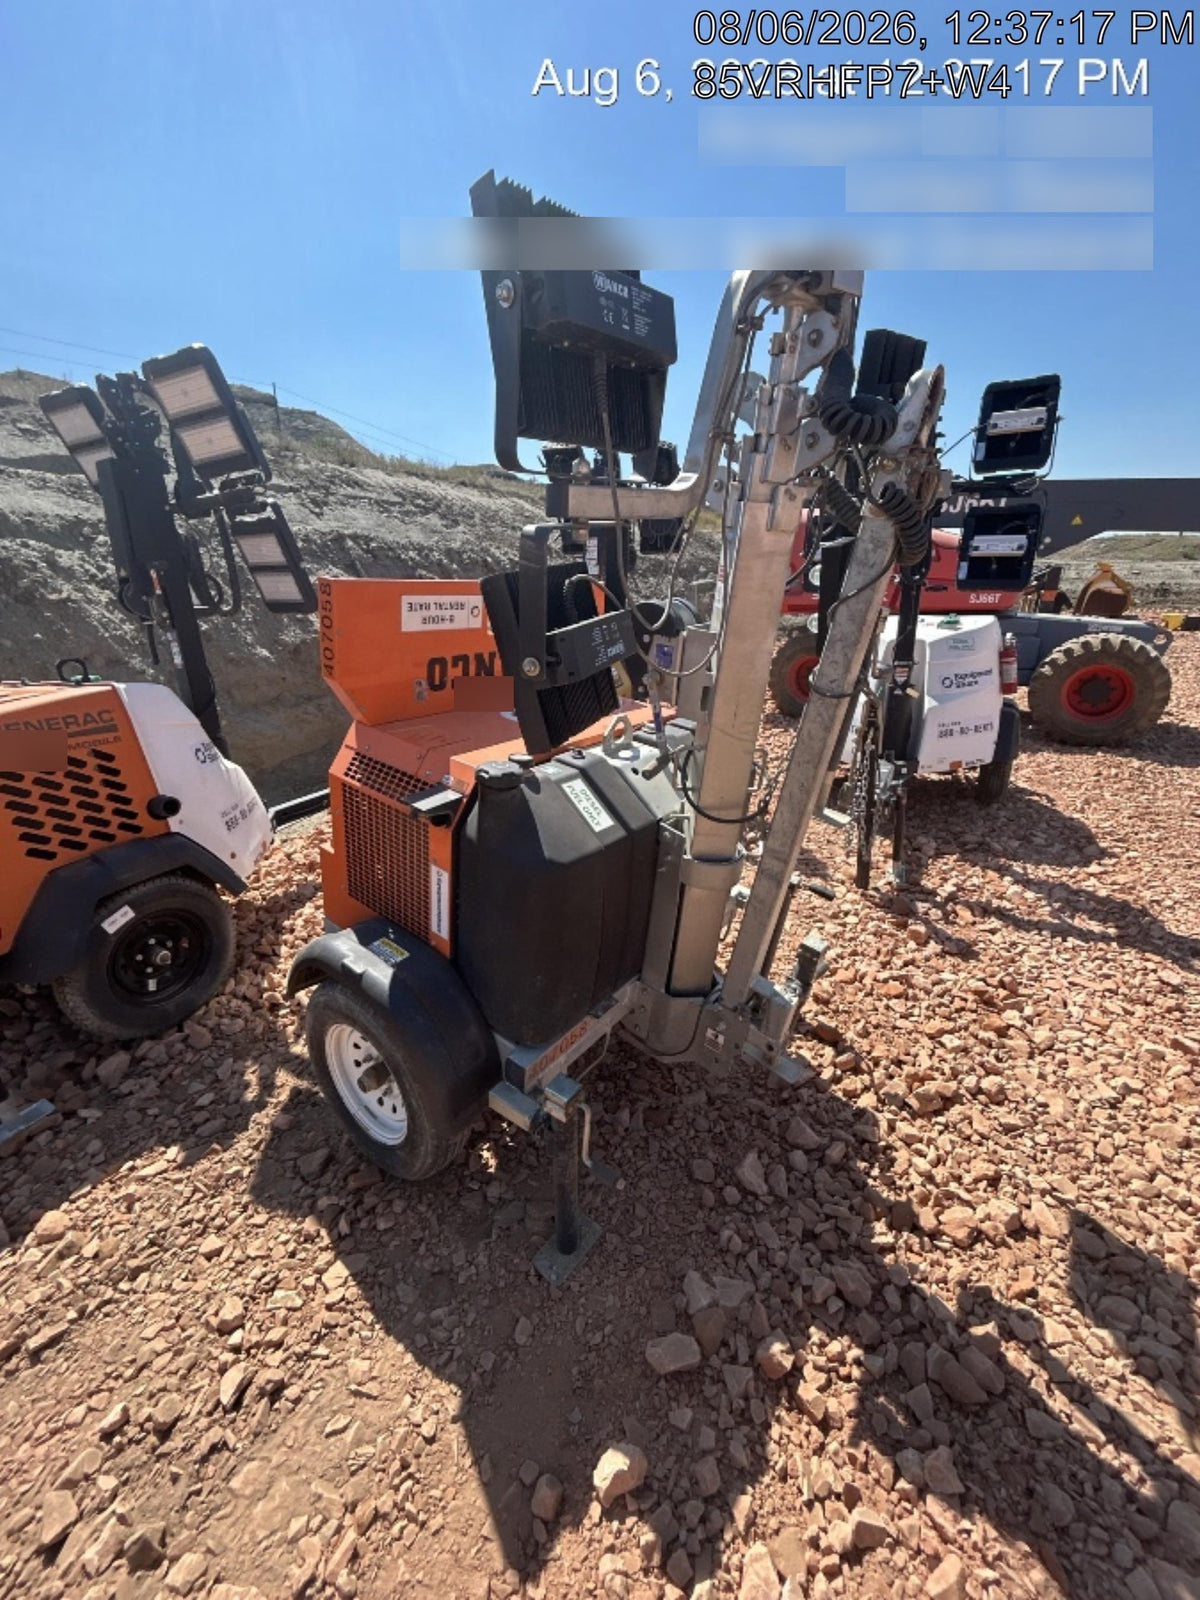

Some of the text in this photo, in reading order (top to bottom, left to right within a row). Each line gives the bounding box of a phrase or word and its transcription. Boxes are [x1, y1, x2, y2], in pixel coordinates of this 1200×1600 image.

[406, 601, 467, 612] RENTAL RATE
[320, 581, 334, 676] 407058
[426, 651, 497, 692] NCO
[2, 708, 116, 731] ENERAC
